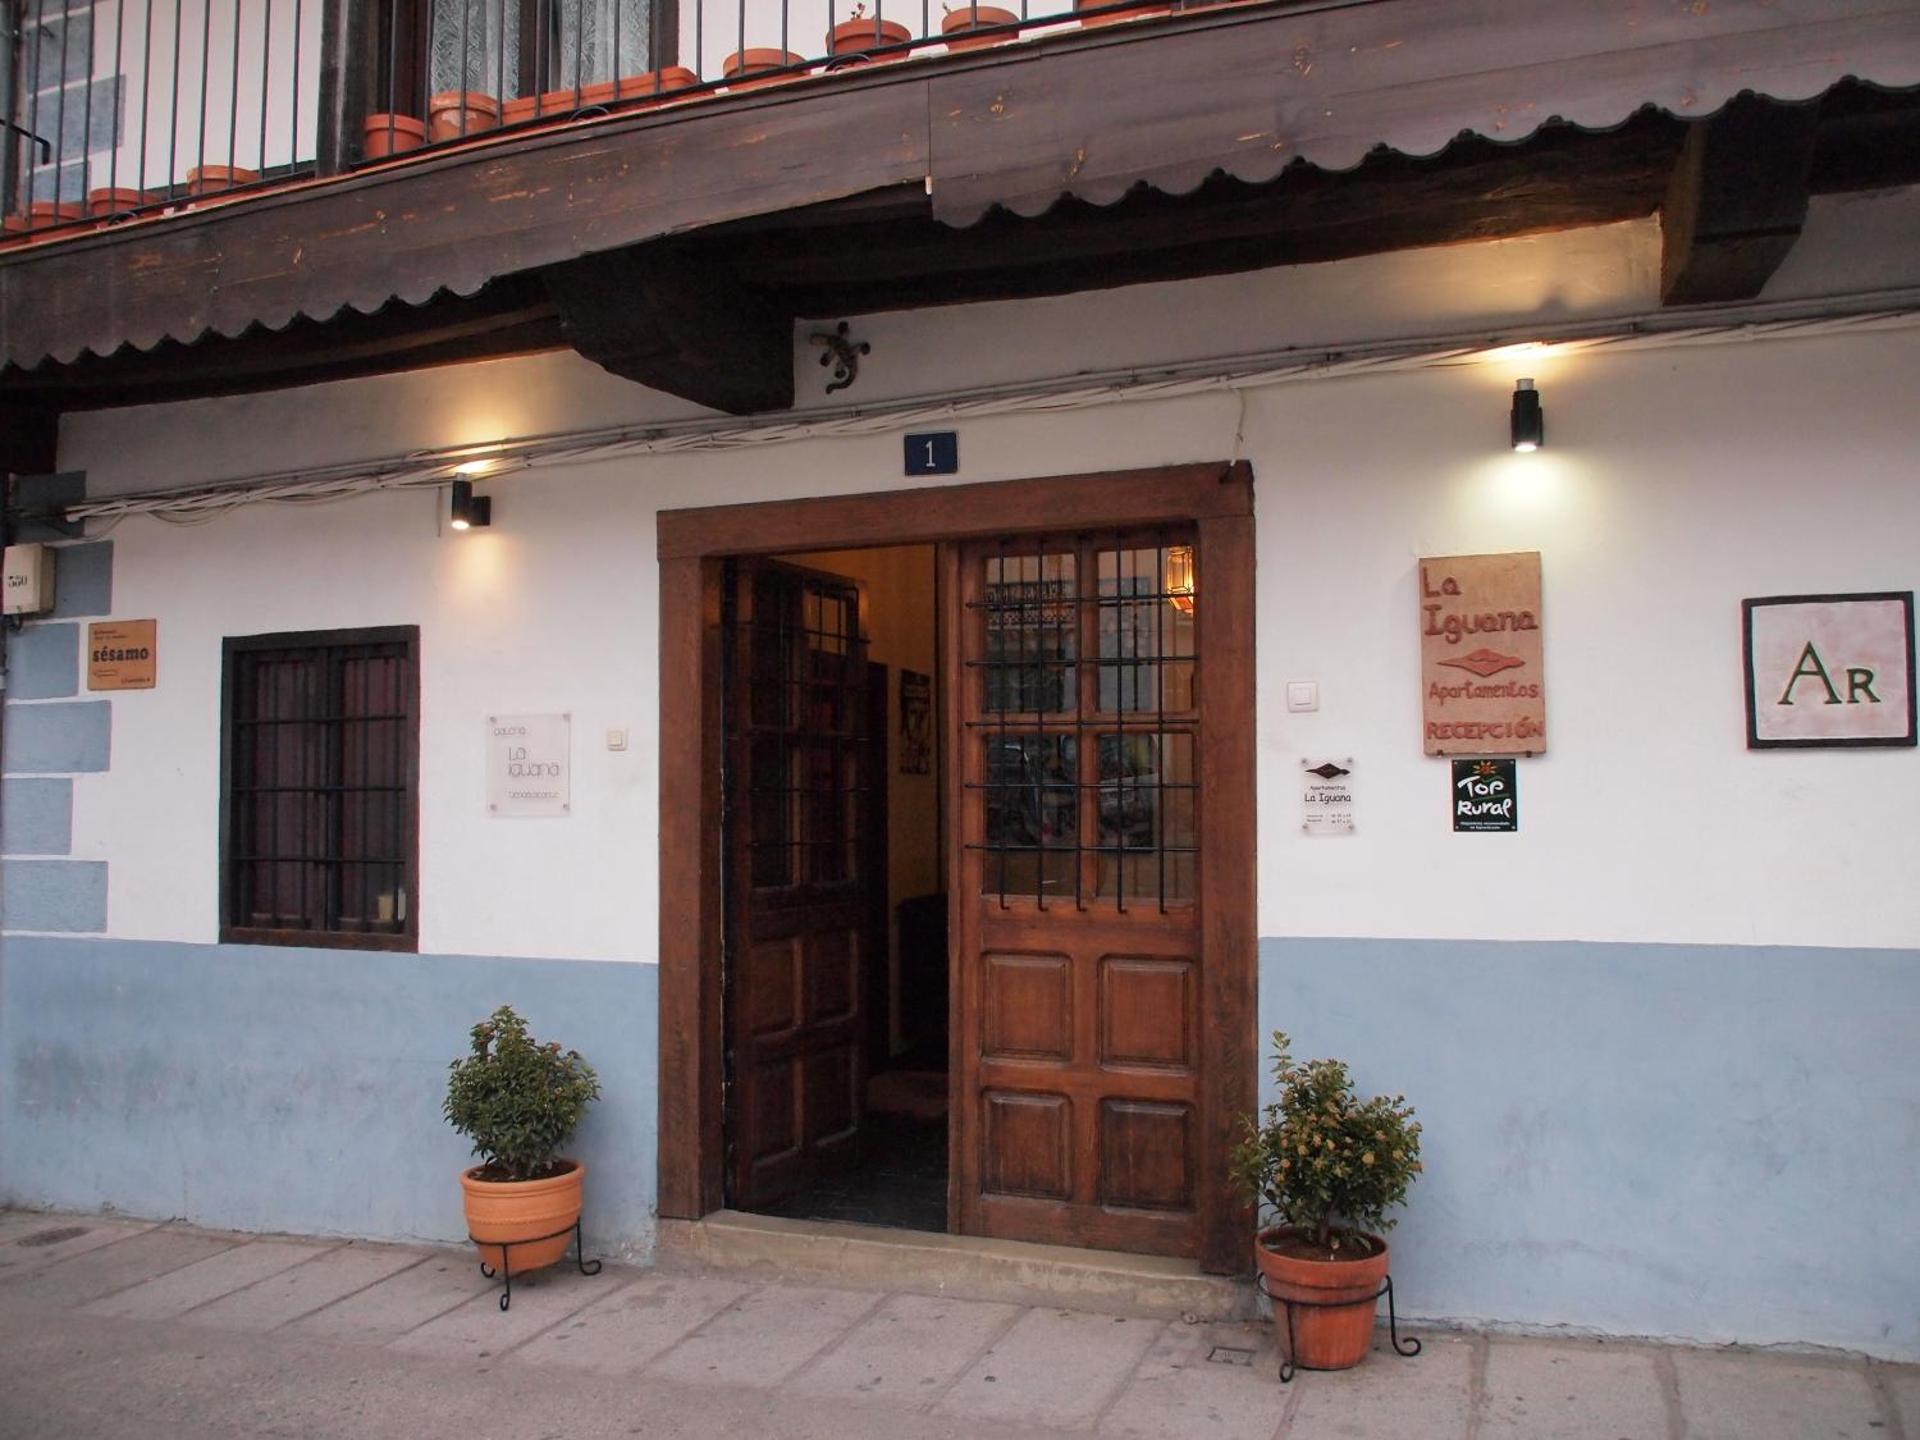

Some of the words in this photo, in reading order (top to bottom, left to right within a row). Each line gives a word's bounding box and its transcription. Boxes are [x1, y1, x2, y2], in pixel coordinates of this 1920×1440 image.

[925, 440, 936, 467] 1
[1423, 567, 1461, 598] La
[1424, 604, 1538, 644] Iguana
[93, 645, 149, 662] sésamo
[1429, 680, 1539, 706] Apartamentos
[1427, 716, 1544, 740] RECEPCIÓN
[1304, 793, 1316, 802] La
[1319, 792, 1351, 805] Iguana
[1457, 798, 1512, 818] Rural
